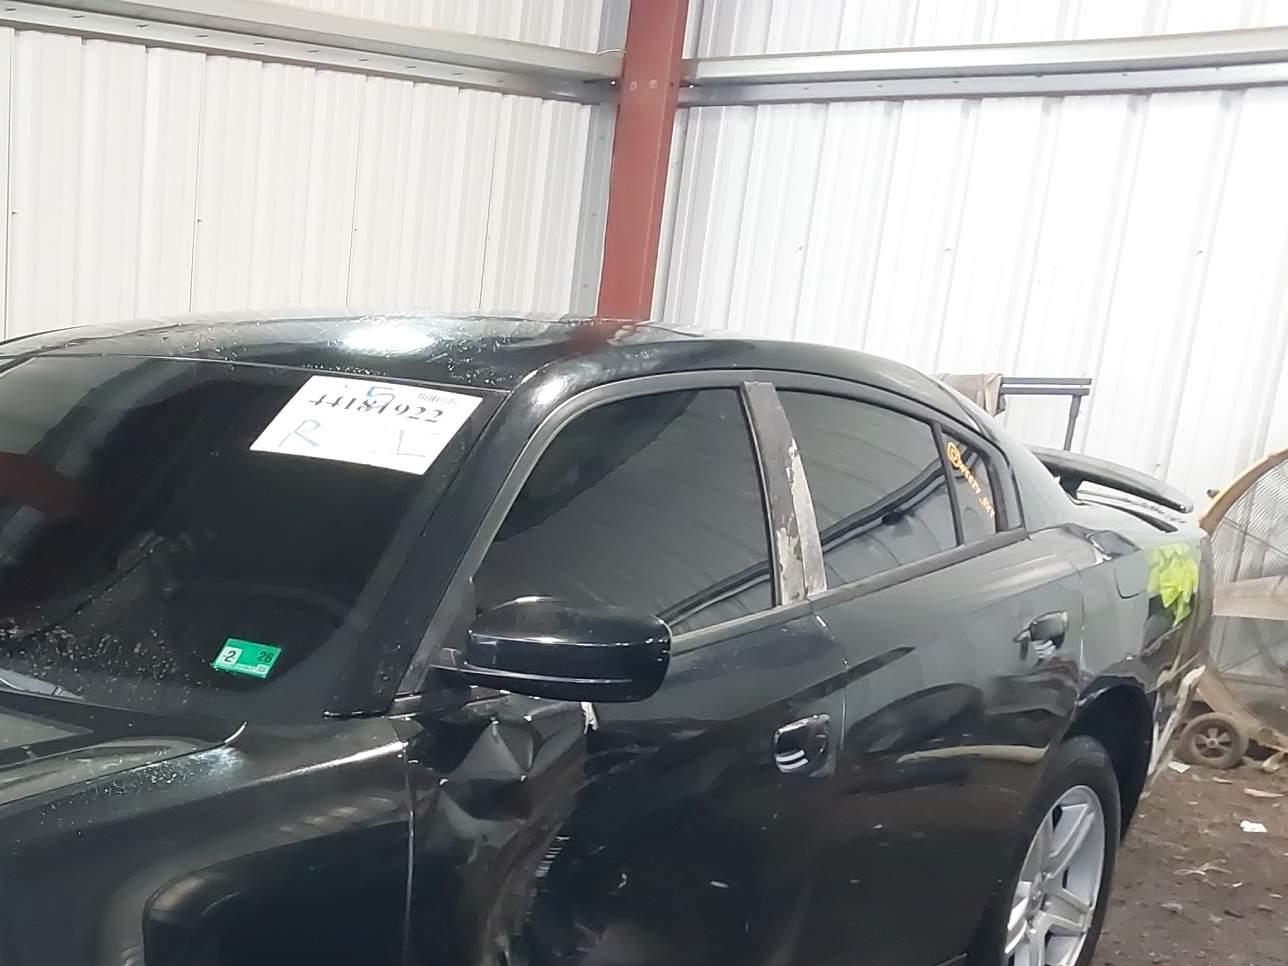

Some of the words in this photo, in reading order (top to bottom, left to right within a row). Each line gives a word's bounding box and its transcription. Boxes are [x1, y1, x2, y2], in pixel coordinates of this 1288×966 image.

[308, 393, 444, 424] 44181922
[223, 650, 238, 663] 2
[257, 650, 275, 664] 26
